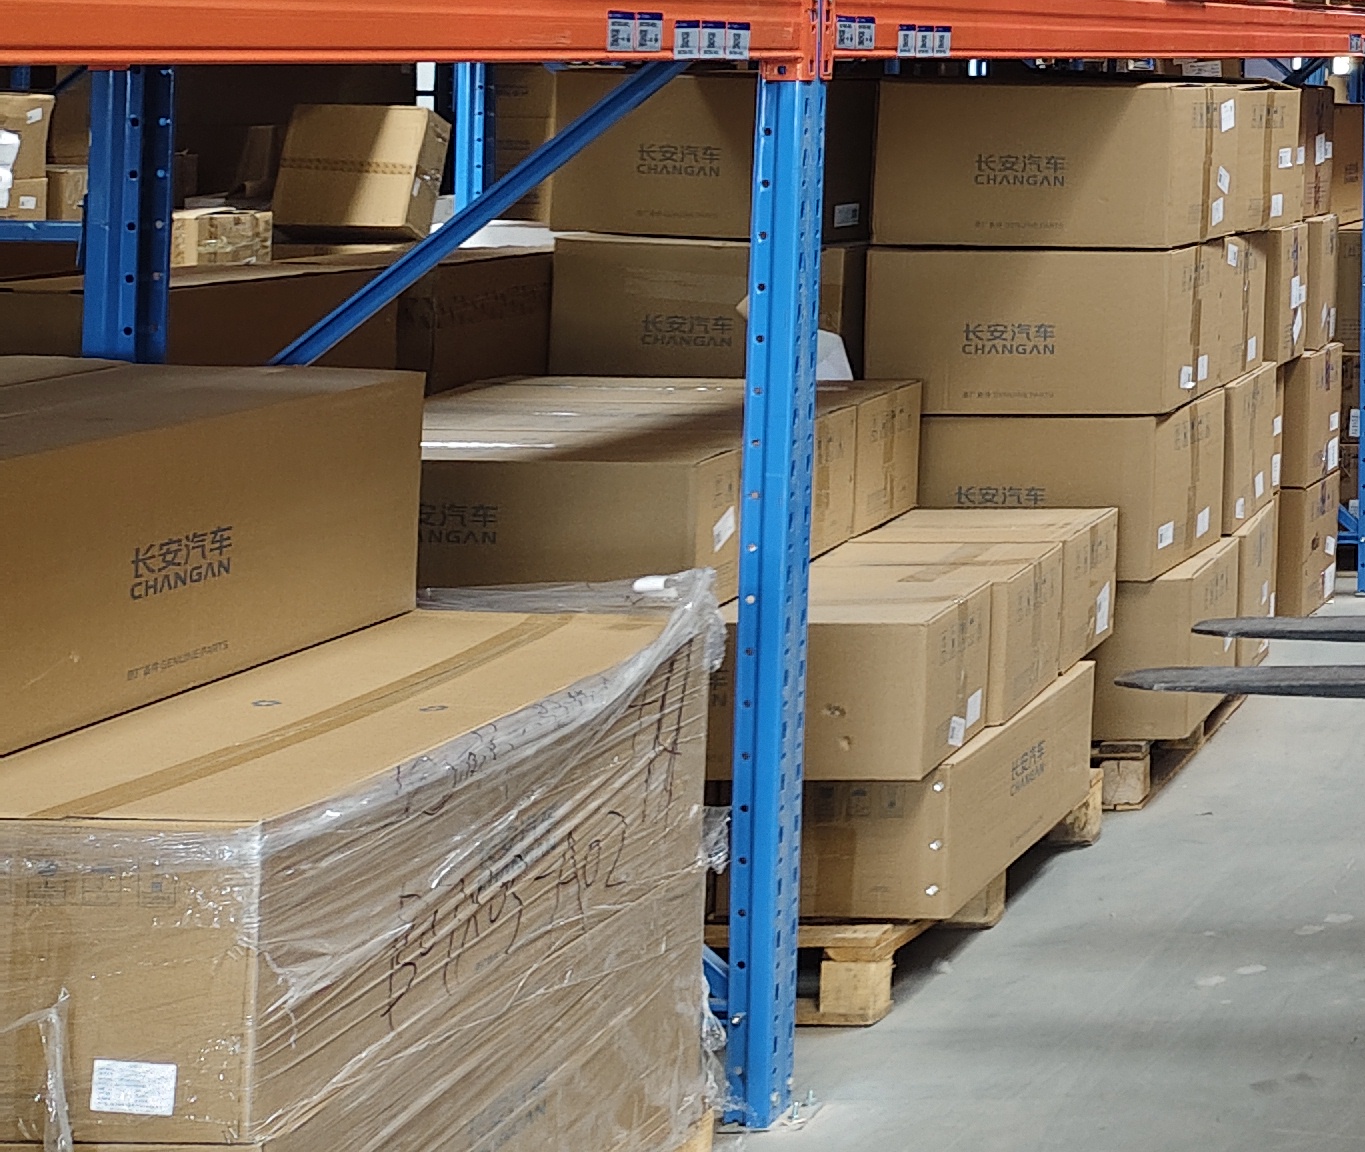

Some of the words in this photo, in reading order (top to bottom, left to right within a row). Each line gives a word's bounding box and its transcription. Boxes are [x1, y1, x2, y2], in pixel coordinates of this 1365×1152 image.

[637, 143, 722, 164] 长安汽车
[975, 153, 1066, 174] 长安汽车
[636, 164, 721, 177] CHANGAN
[973, 174, 1065, 187] CHANGAN
[642, 314, 733, 335] 长安汽车
[963, 323, 1056, 342] 长安汽车
[641, 334, 733, 347] CHANGAN
[961, 342, 1056, 356] CHANGAN
[955, 485, 1046, 505] 长安汽车
[417, 503, 499, 528] 安汽车
[131, 525, 234, 579] 长安汽车
[129, 557, 231, 601] CHANGAN
